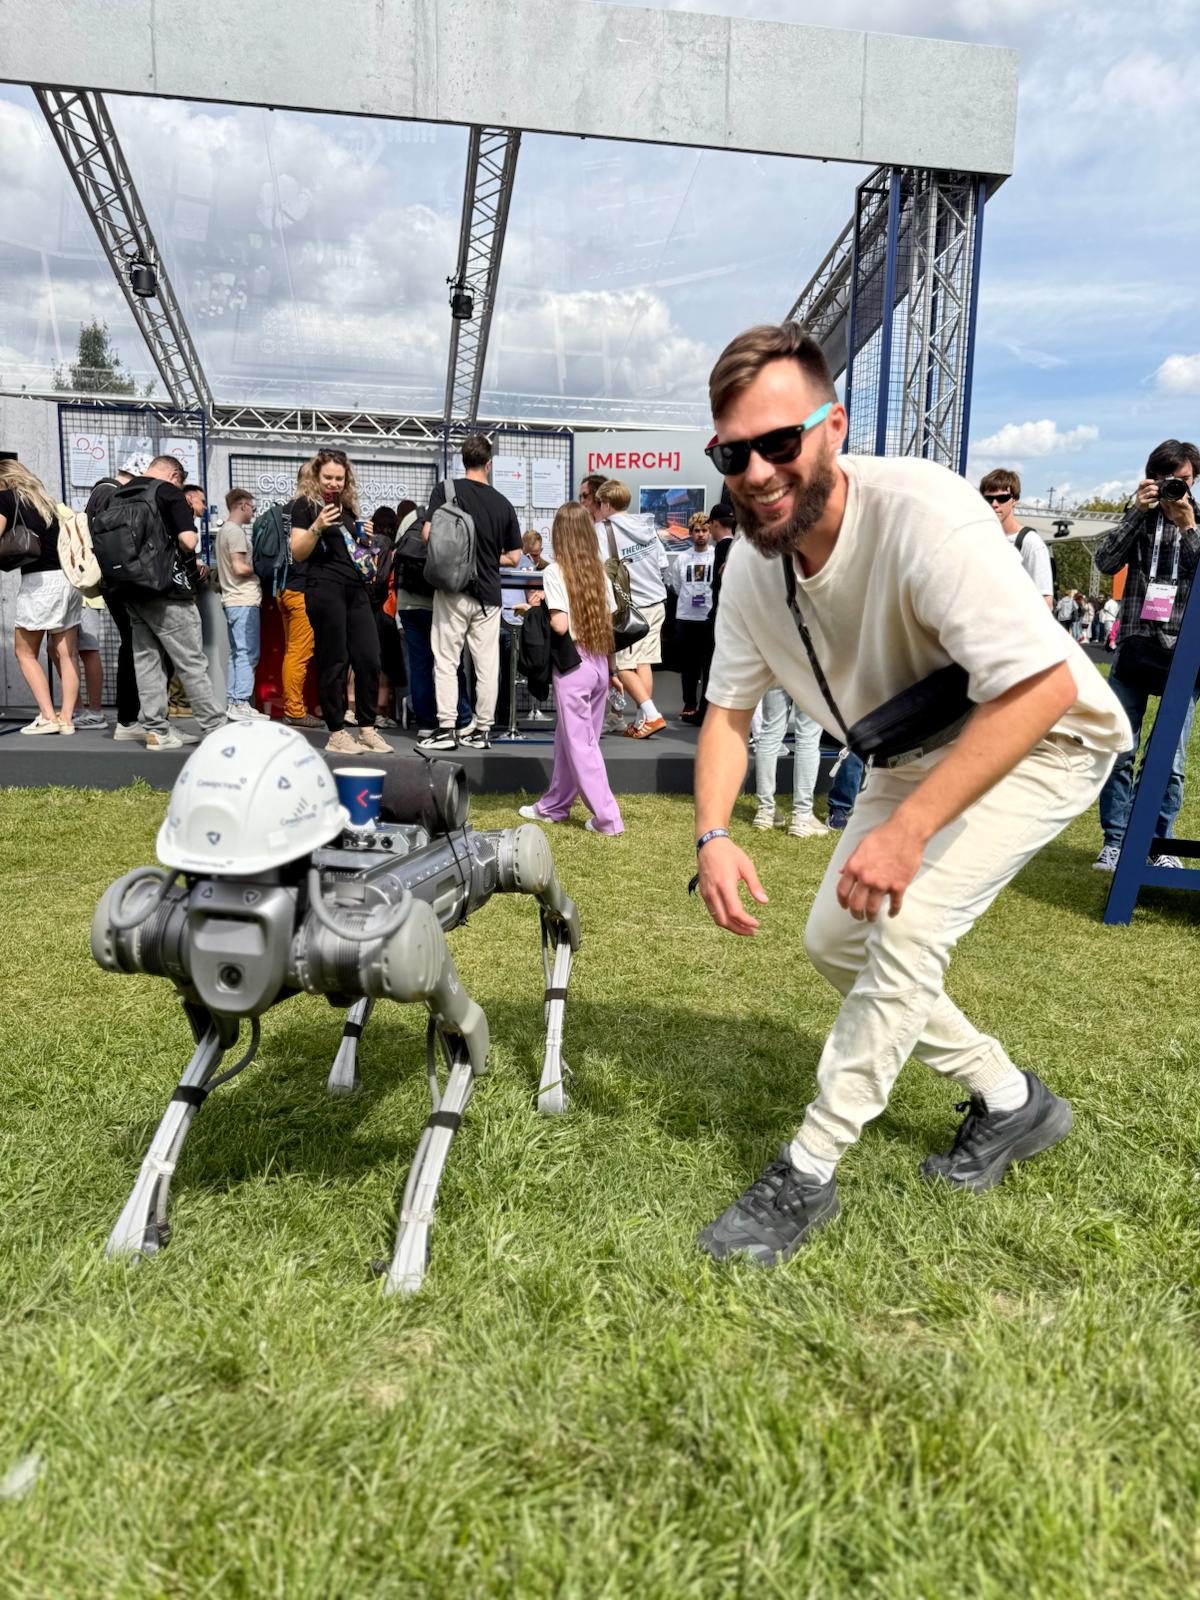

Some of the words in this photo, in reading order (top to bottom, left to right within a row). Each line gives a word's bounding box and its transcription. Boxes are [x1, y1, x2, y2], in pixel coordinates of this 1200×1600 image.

[588, 451, 680, 472] [MERCH]
[258, 473, 298, 498] Сбр
[1145, 605, 1168, 613] ПРЕССА
